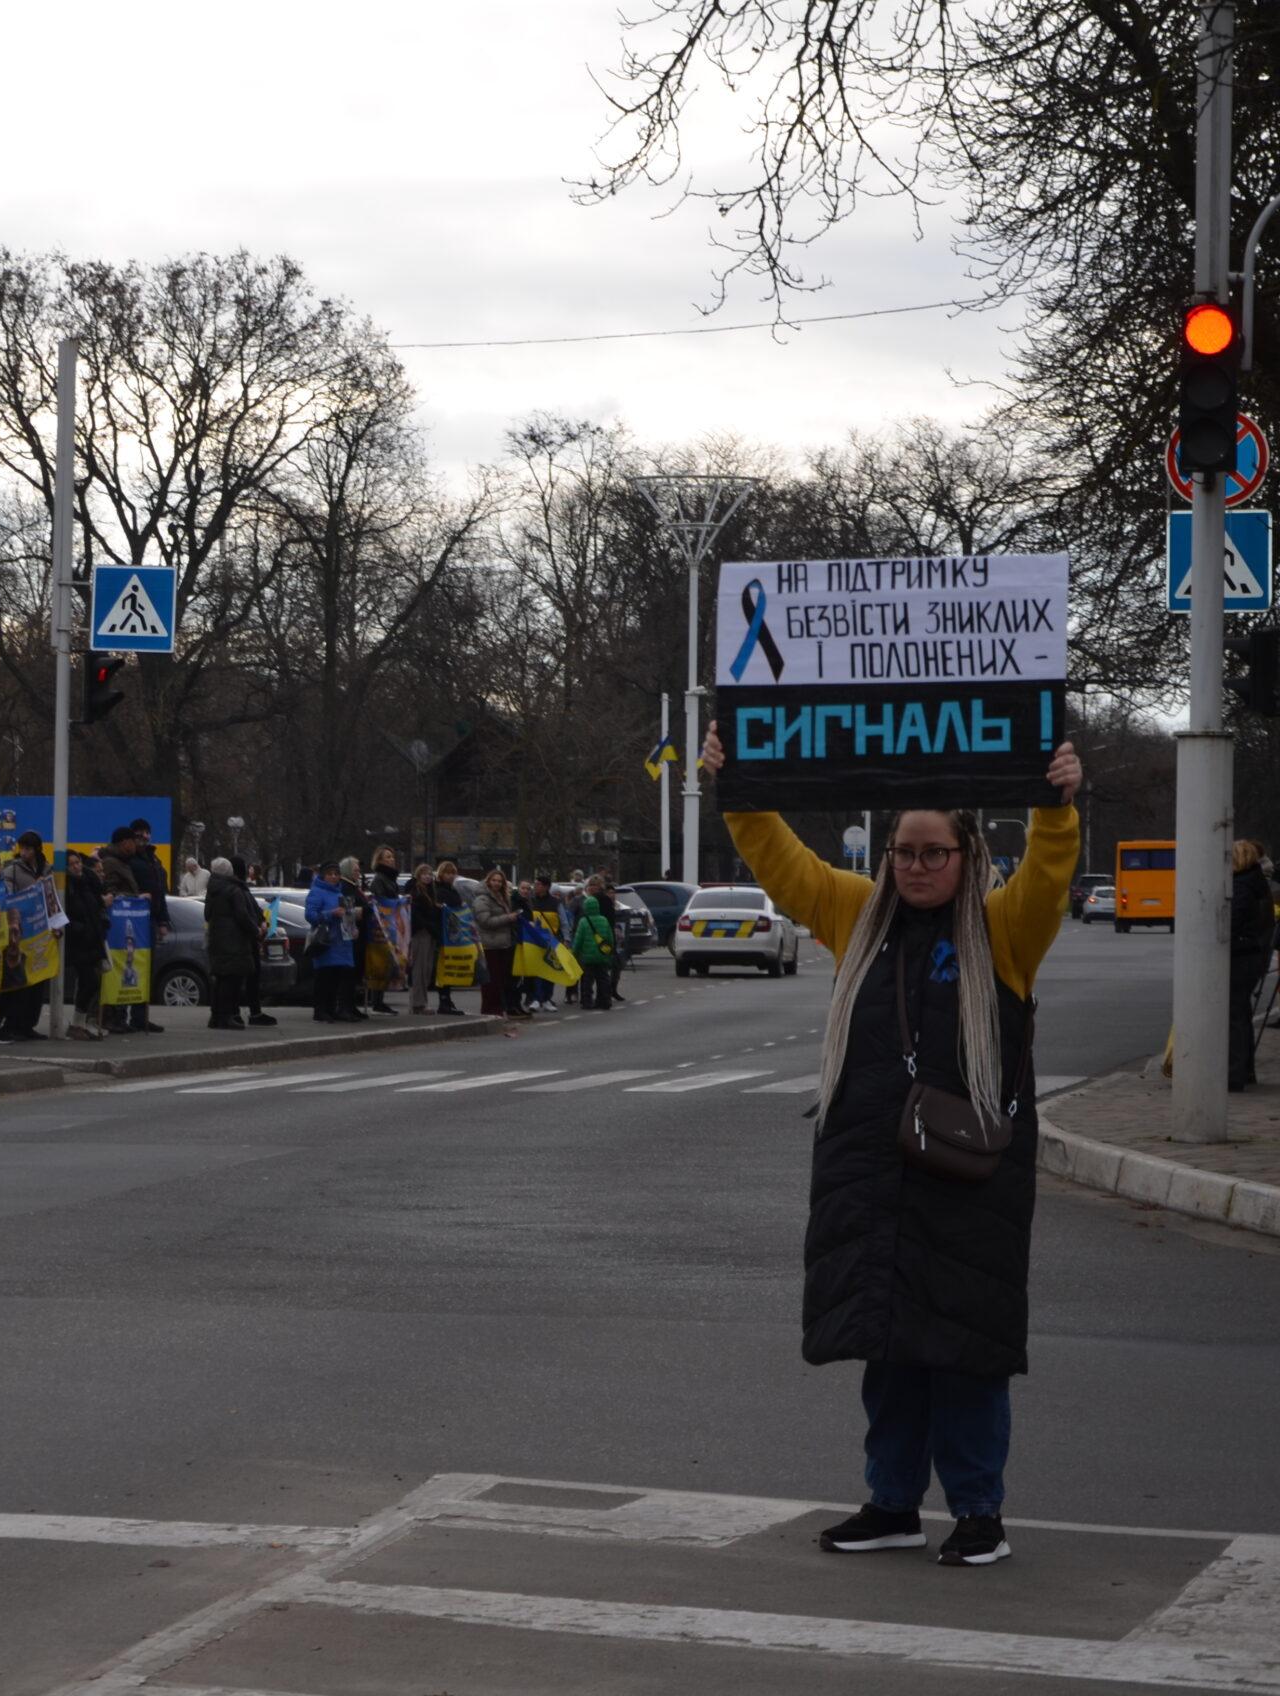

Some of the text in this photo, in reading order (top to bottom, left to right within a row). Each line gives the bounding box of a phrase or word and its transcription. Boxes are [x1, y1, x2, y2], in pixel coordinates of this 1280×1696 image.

[777, 557, 989, 594] НА ПІДТРИМКУ
[924, 598, 1054, 635] ЗНИКЛИХ
[850, 638, 1023, 679] ПОЛОНЕНИХ
[735, 698, 1012, 760] СИГНАЛЬ
